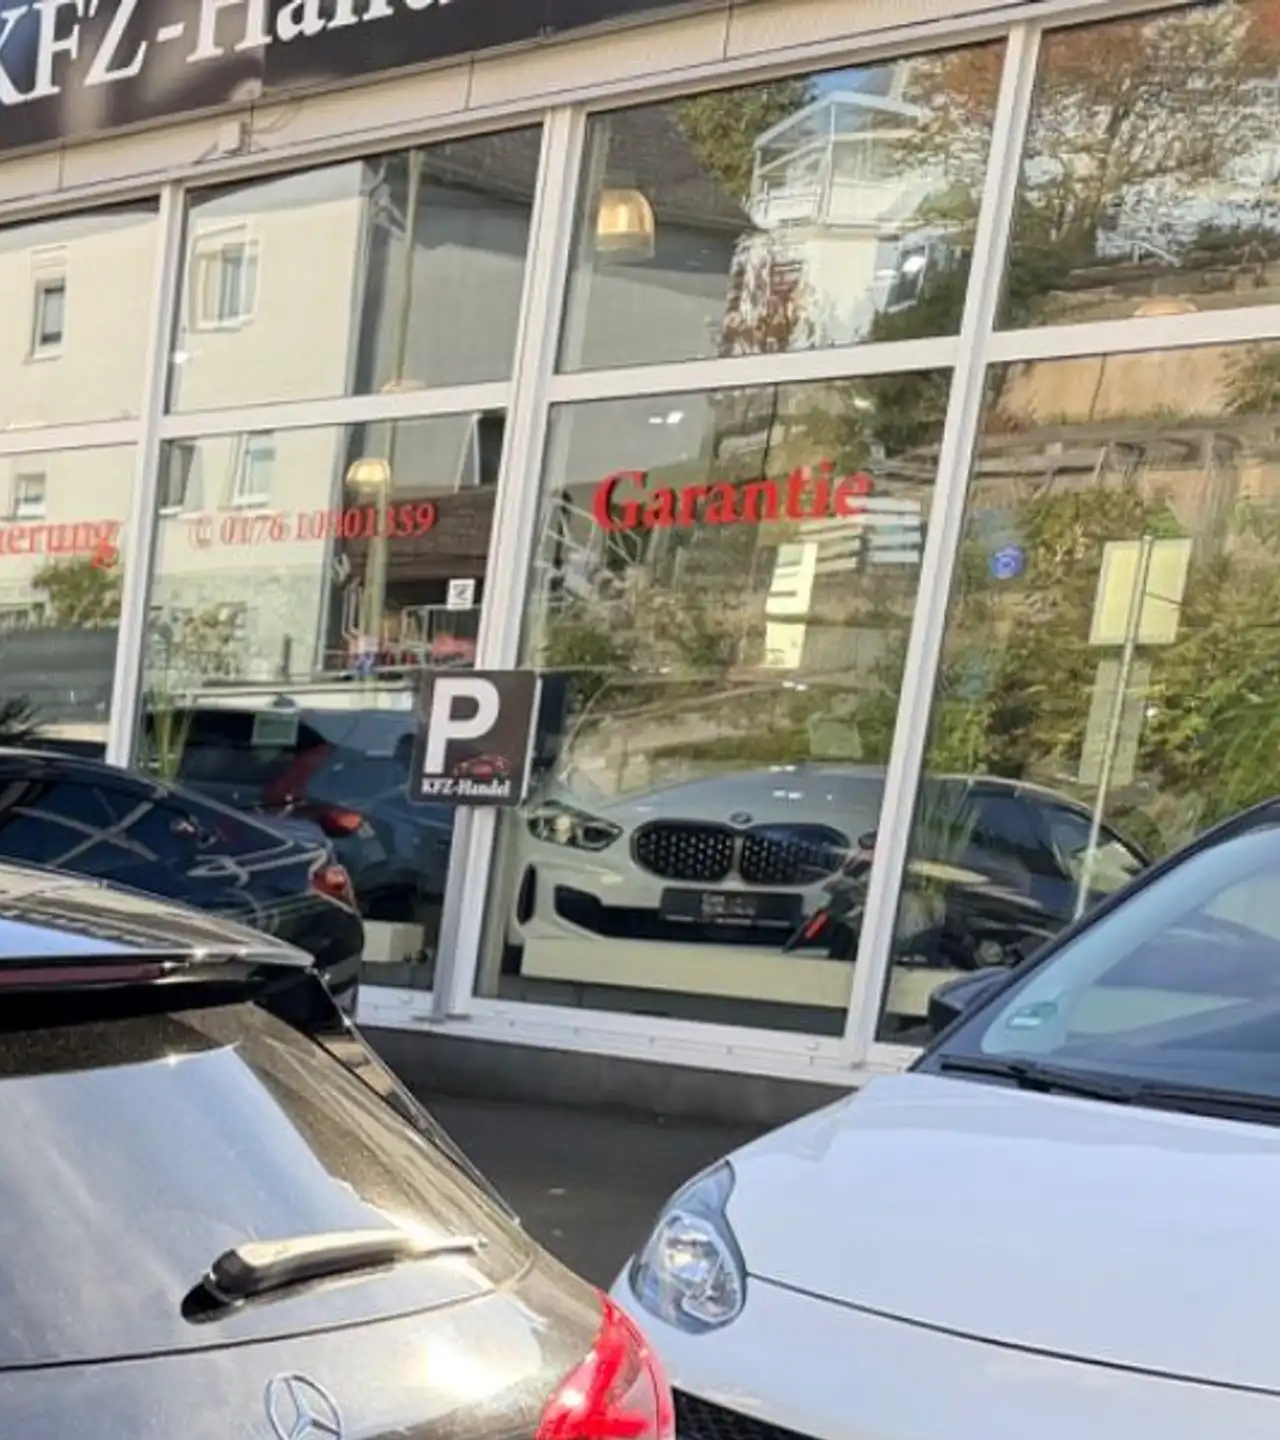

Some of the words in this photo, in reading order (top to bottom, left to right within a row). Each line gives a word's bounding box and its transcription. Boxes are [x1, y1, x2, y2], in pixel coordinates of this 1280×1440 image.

[592, 460, 873, 533] Garantie
[424, 677, 500, 774] P
[422, 777, 511, 797] KFZ-Handel
